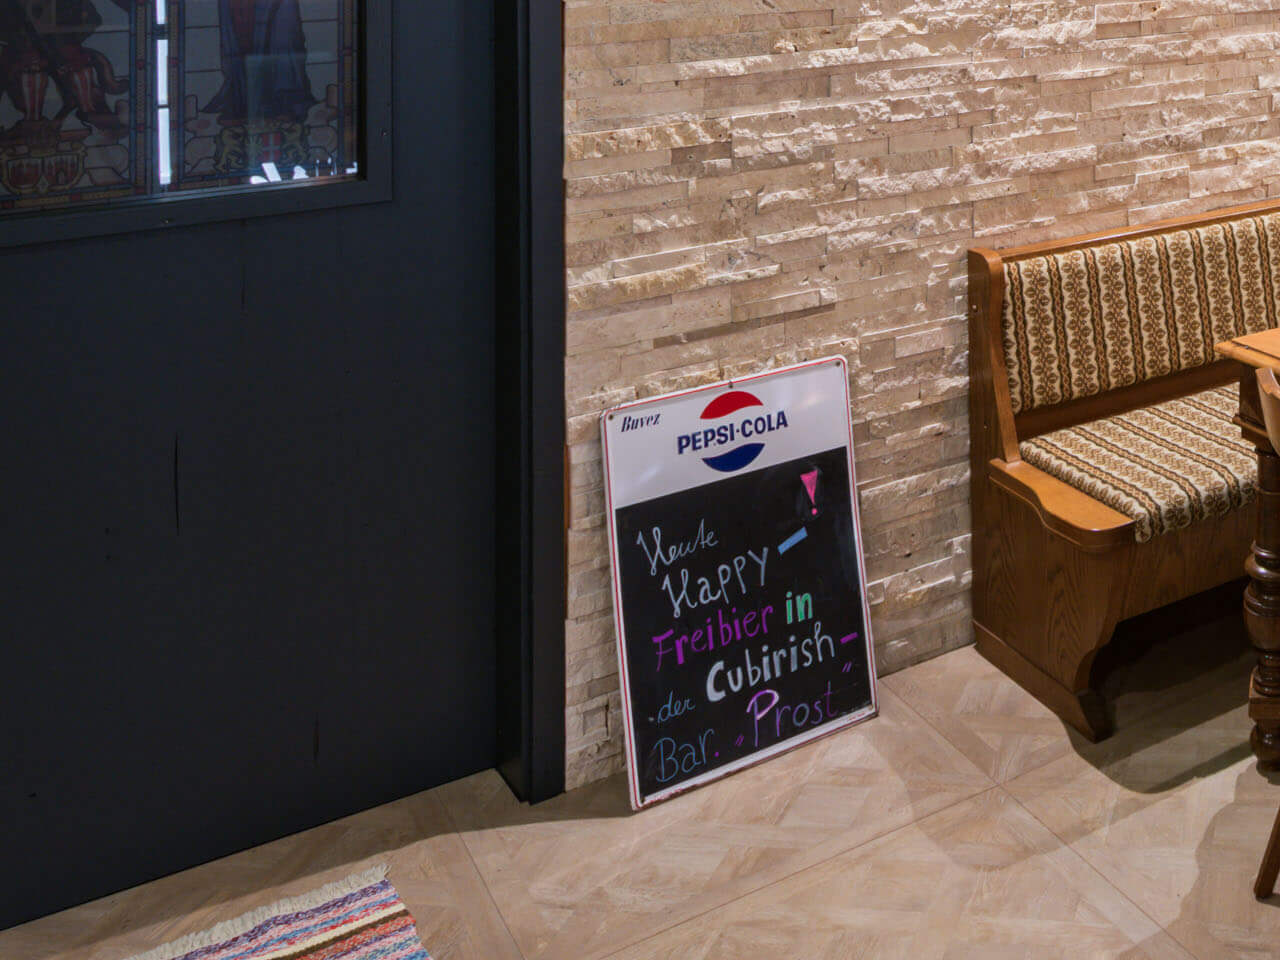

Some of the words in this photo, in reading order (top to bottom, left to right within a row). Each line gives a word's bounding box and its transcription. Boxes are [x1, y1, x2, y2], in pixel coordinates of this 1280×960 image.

[621, 413, 661, 433] Buvez
[636, 519, 718, 576] Heute
[652, 605, 773, 671] Freibier
[785, 591, 814, 625] in
[656, 691, 696, 724] der
